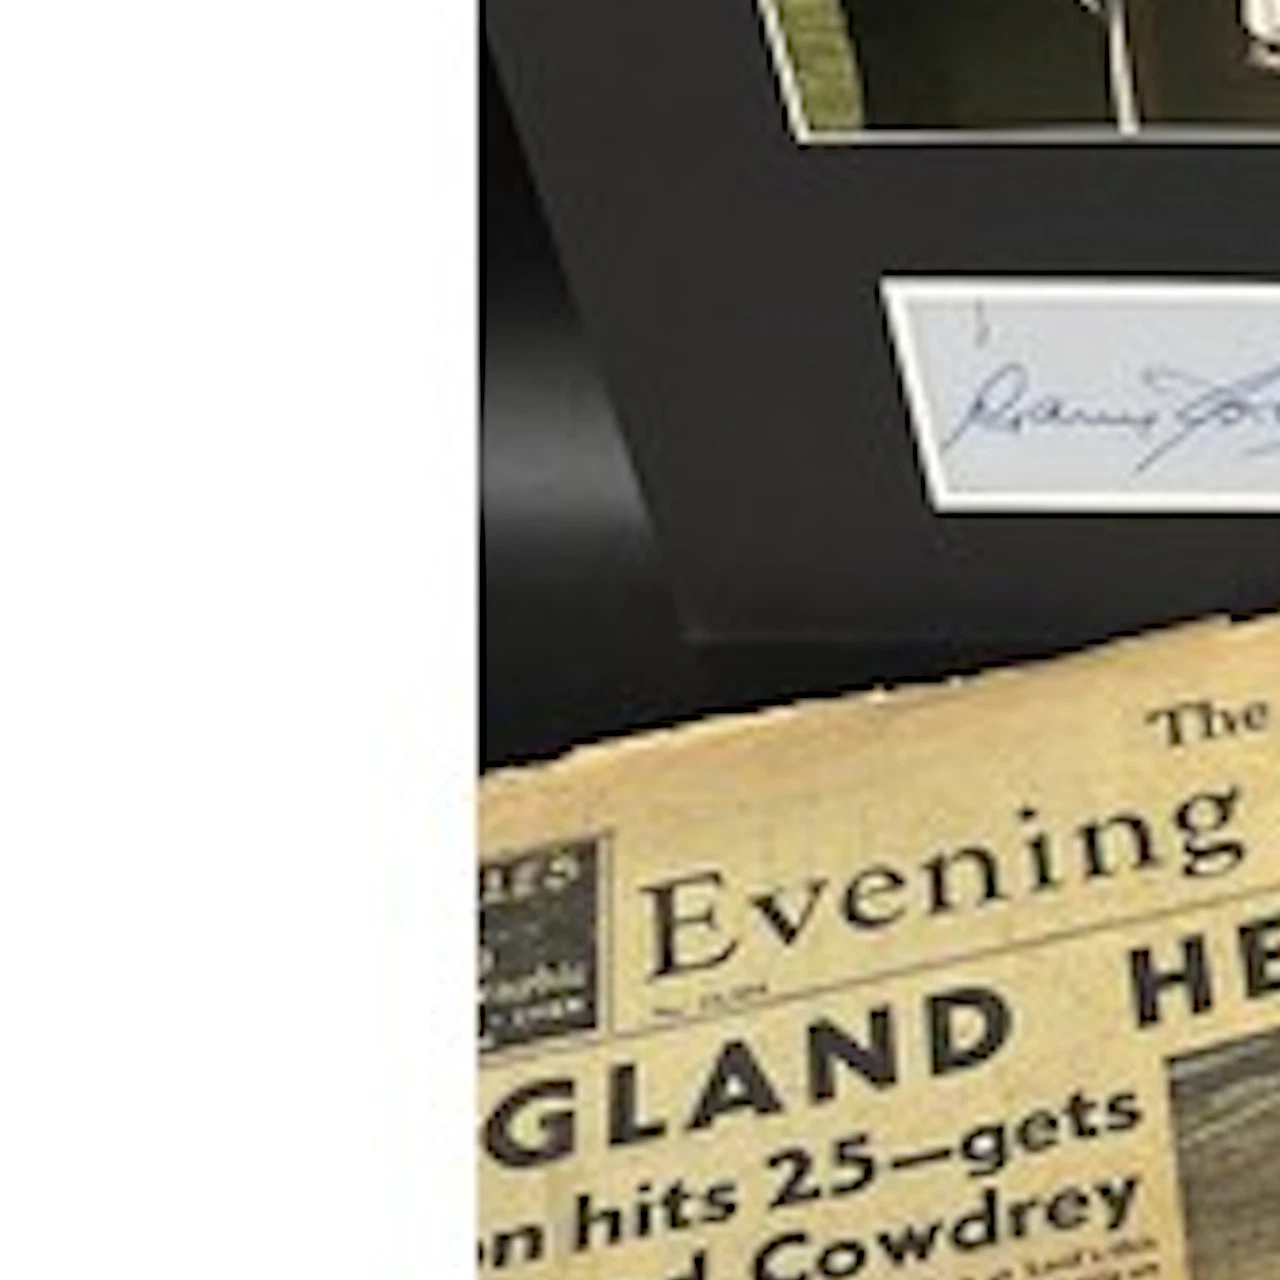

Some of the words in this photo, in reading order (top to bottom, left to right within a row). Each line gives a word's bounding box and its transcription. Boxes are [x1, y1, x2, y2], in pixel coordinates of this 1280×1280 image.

[1146, 694, 1270, 750] The
[638, 784, 1246, 984] Evening
[484, 986, 1014, 1170] GLAND
[573, 1172, 740, 1256] hits
